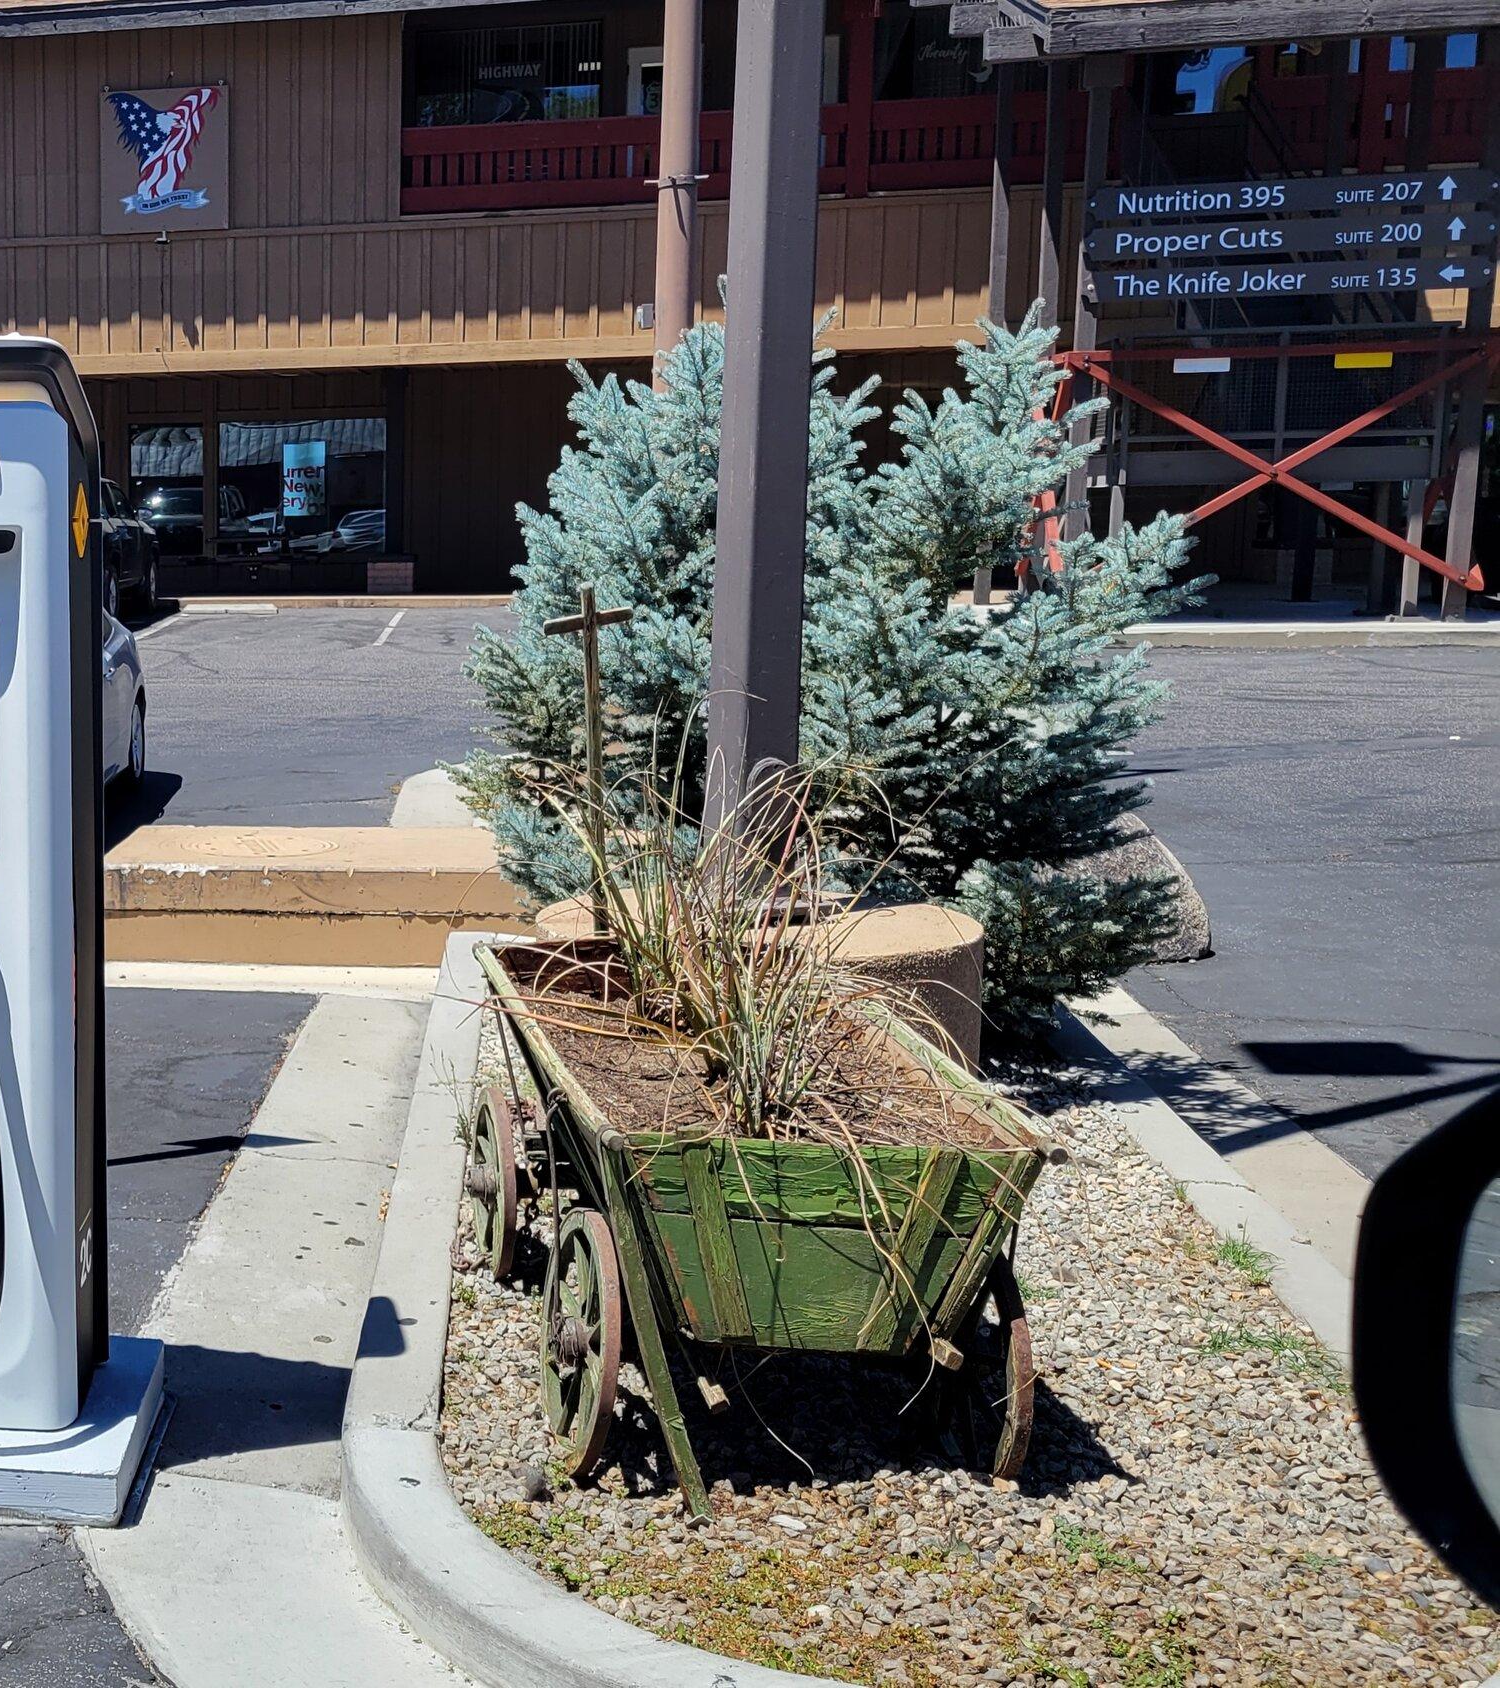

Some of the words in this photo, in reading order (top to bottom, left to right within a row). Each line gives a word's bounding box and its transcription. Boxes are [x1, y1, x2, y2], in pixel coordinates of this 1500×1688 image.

[478, 63, 541, 80] HIGHWAY
[1118, 189, 1231, 214] Nutrition
[1238, 185, 1286, 208] 395
[1335, 190, 1375, 203] SUITE
[1381, 181, 1423, 201] 207
[1115, 232, 1212, 257] Proper
[1219, 227, 1284, 249] Cuts
[1335, 231, 1374, 244] SUITE
[1380, 222, 1422, 243] 200
[1113, 274, 1160, 297] The
[1167, 271, 1231, 295] Knife
[1236, 268, 1306, 293] Joker
[1330, 275, 1370, 288] SUITE
[1376, 268, 1417, 287] 135
[79, 1228, 92, 1288] 2C
